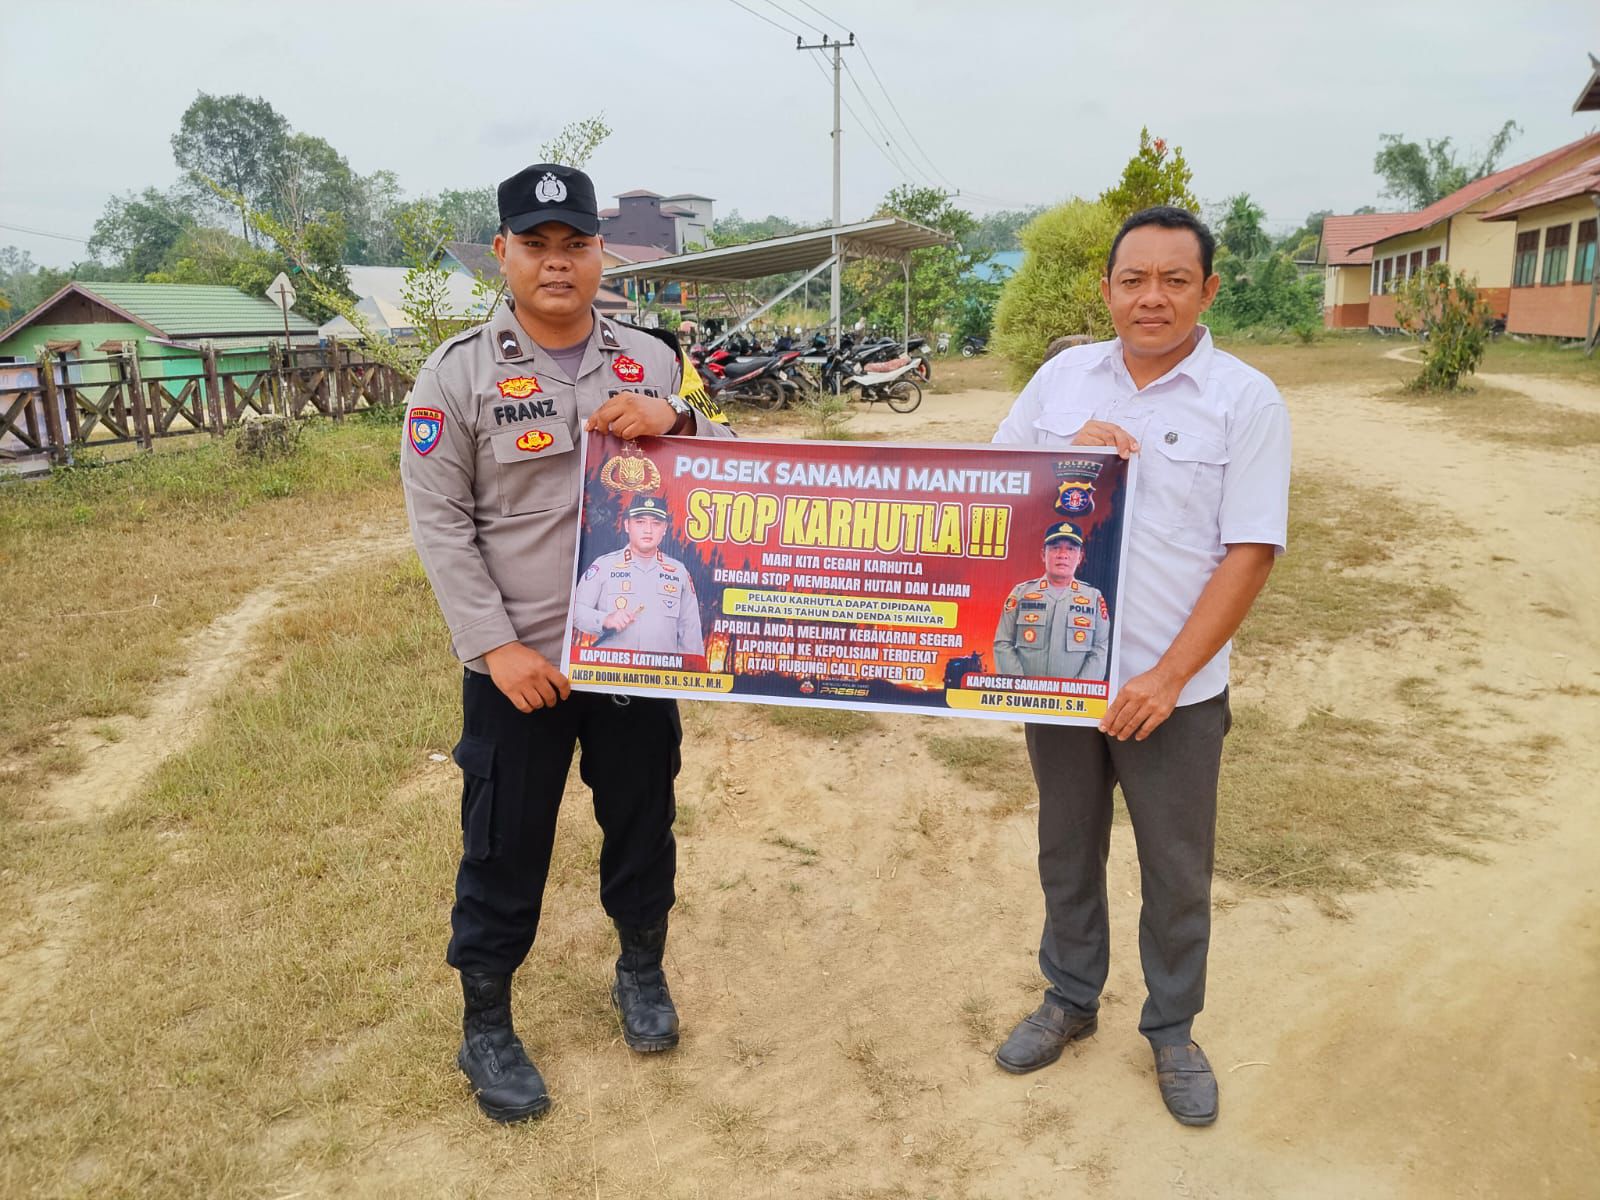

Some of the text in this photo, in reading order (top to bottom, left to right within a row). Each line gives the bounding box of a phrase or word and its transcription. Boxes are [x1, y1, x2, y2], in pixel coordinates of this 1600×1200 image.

[494, 399, 557, 425] FRANZ
[675, 456, 1031, 495] POLSEK SANAMAN MANTIKEI
[686, 488, 1012, 560] STOP KARHUTLA !!!
[762, 553, 923, 575] MARI KITA CEGAH KARHUTLA
[714, 569, 971, 597] DENGAN STOP MEMBAKAR HUTAN DAN LAHAN
[735, 603, 943, 625] PENJARA 15 TAHUN DAN DENDA 15 MILYAR
[748, 593, 931, 613] PELAKU KARHUTLA DAPAT DIPIDANA
[1069, 605, 1094, 615] POLRI
[714, 620, 963, 648] APABILA ANDA MELIHAT KEBAKARAN SEGERA
[579, 649, 683, 669] KAPOLRES KATINGAN
[736, 639, 938, 664] LAPORKAN KE KEPOLISIAN TERDEKAT
[572, 669, 593, 681] AKBP
[595, 671, 621, 683] DODIK
[747, 657, 925, 680] ATAU HUBUNGI CALL CENTER 110
[820, 687, 870, 697] PRESISI
[966, 676, 1106, 696] KAPOLSEK SANAMAN MANTIKEI
[981, 693, 1087, 711] AKP SUWARDI, S.H.
